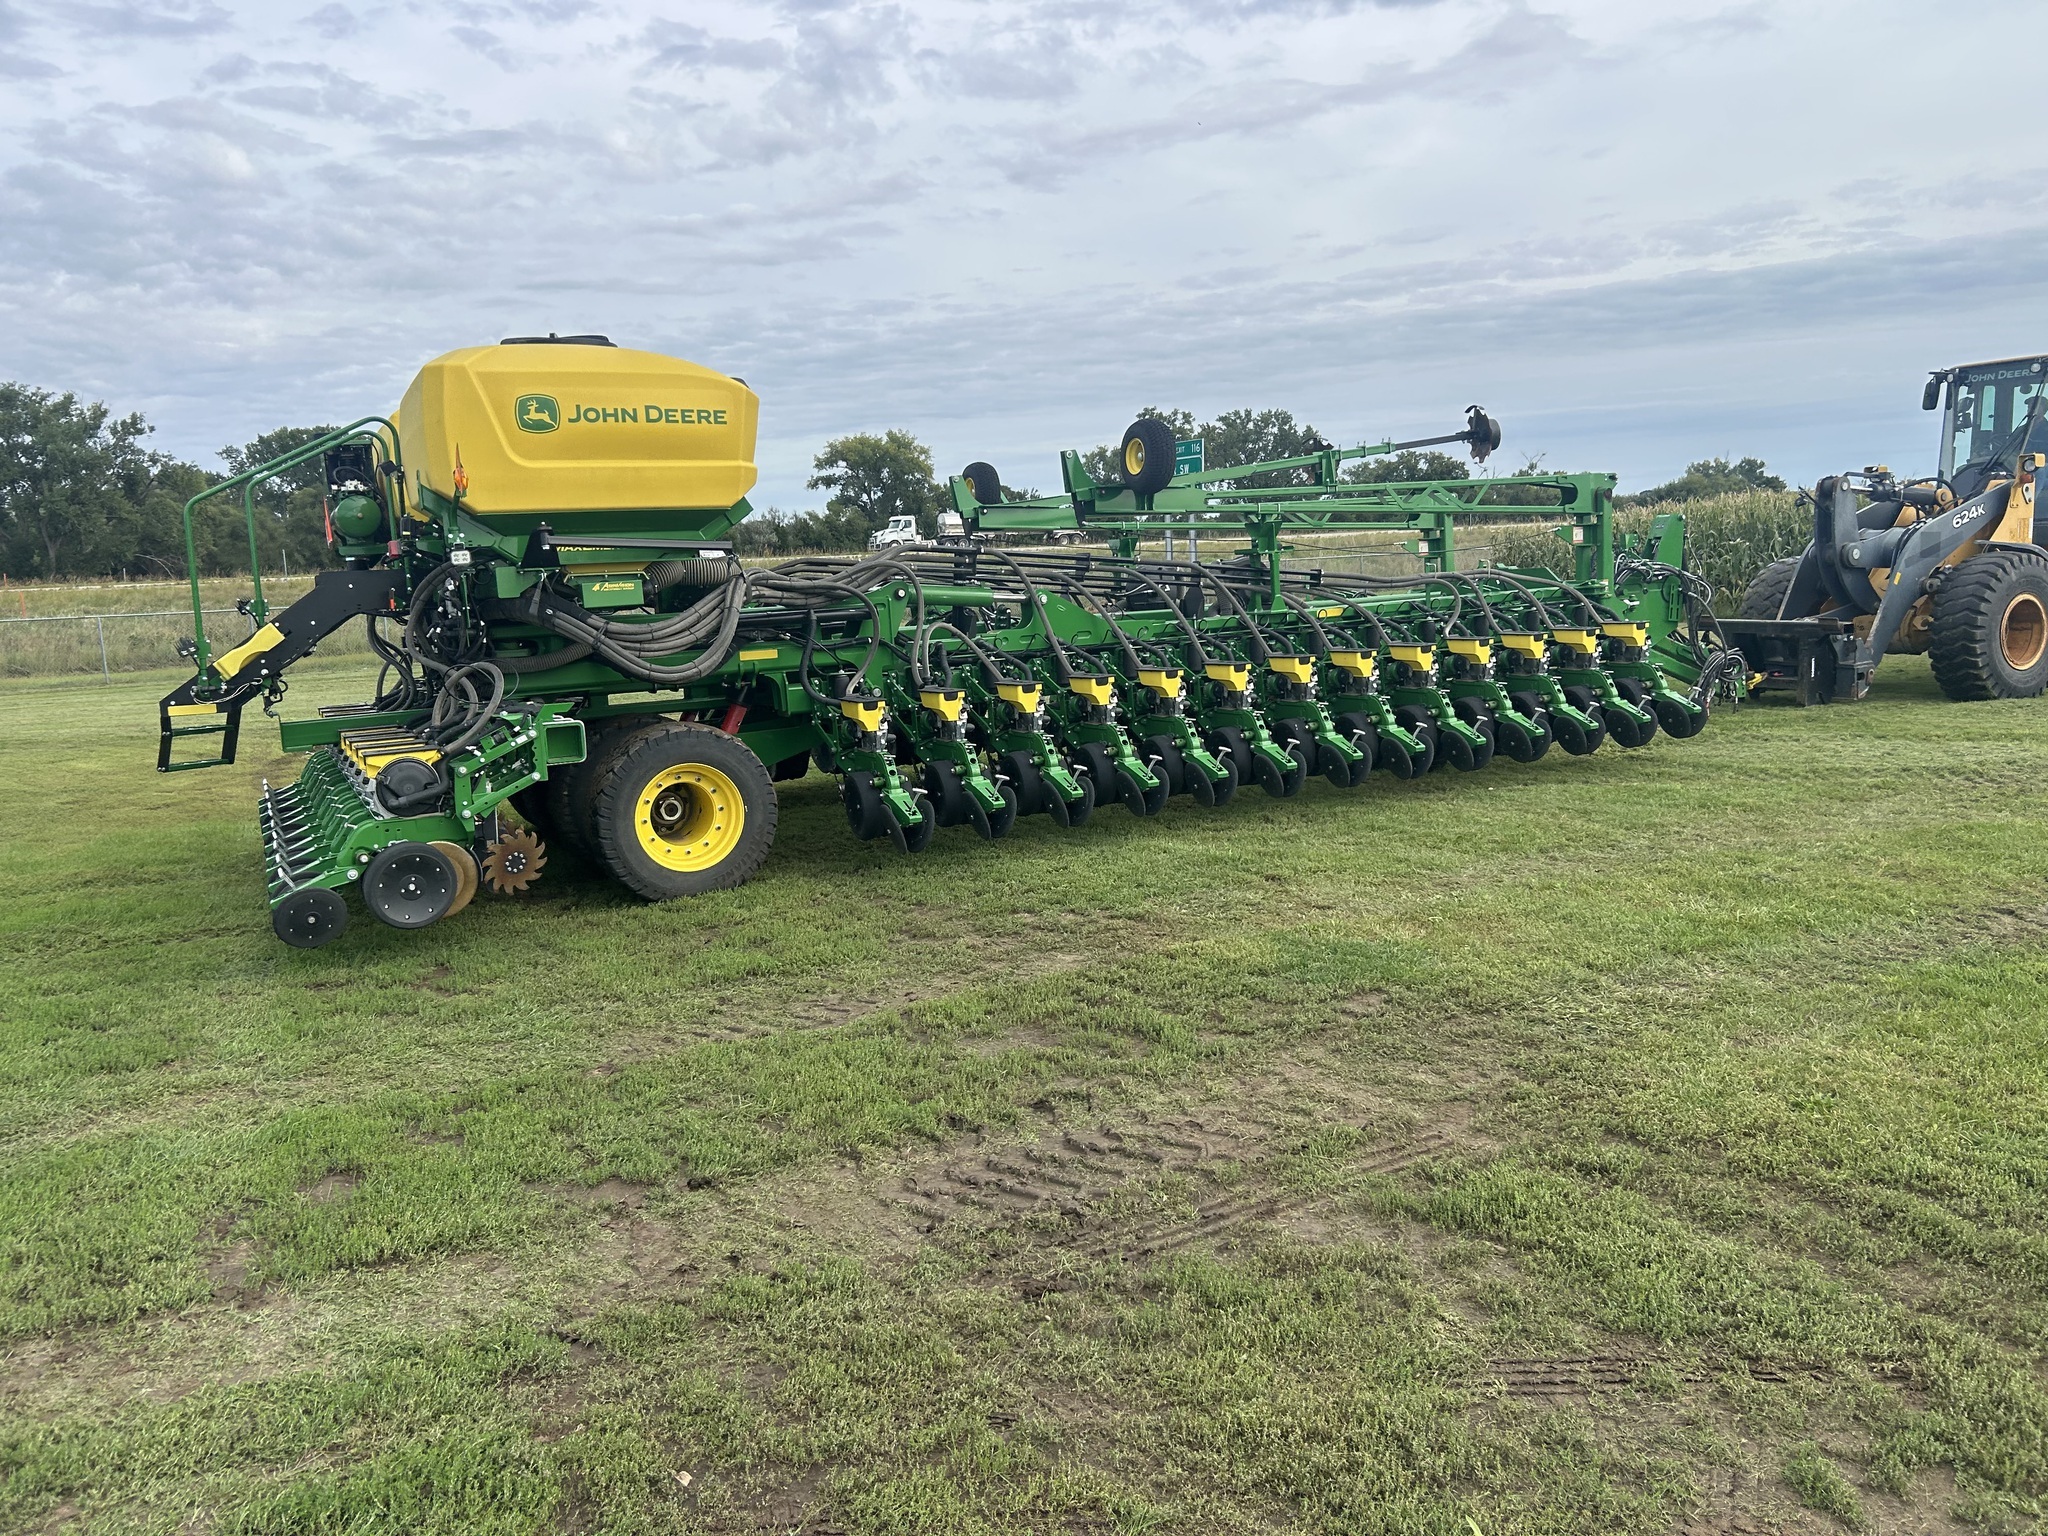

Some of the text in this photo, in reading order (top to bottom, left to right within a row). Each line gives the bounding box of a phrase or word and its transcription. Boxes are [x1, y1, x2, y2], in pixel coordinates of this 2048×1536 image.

[1965, 373, 1995, 383] JOHN
[568, 404, 727, 425] JOHN DEERE
[1191, 443, 1200, 453] 116
[1179, 464, 1189, 474] SW
[1952, 503, 1986, 528] 624K
